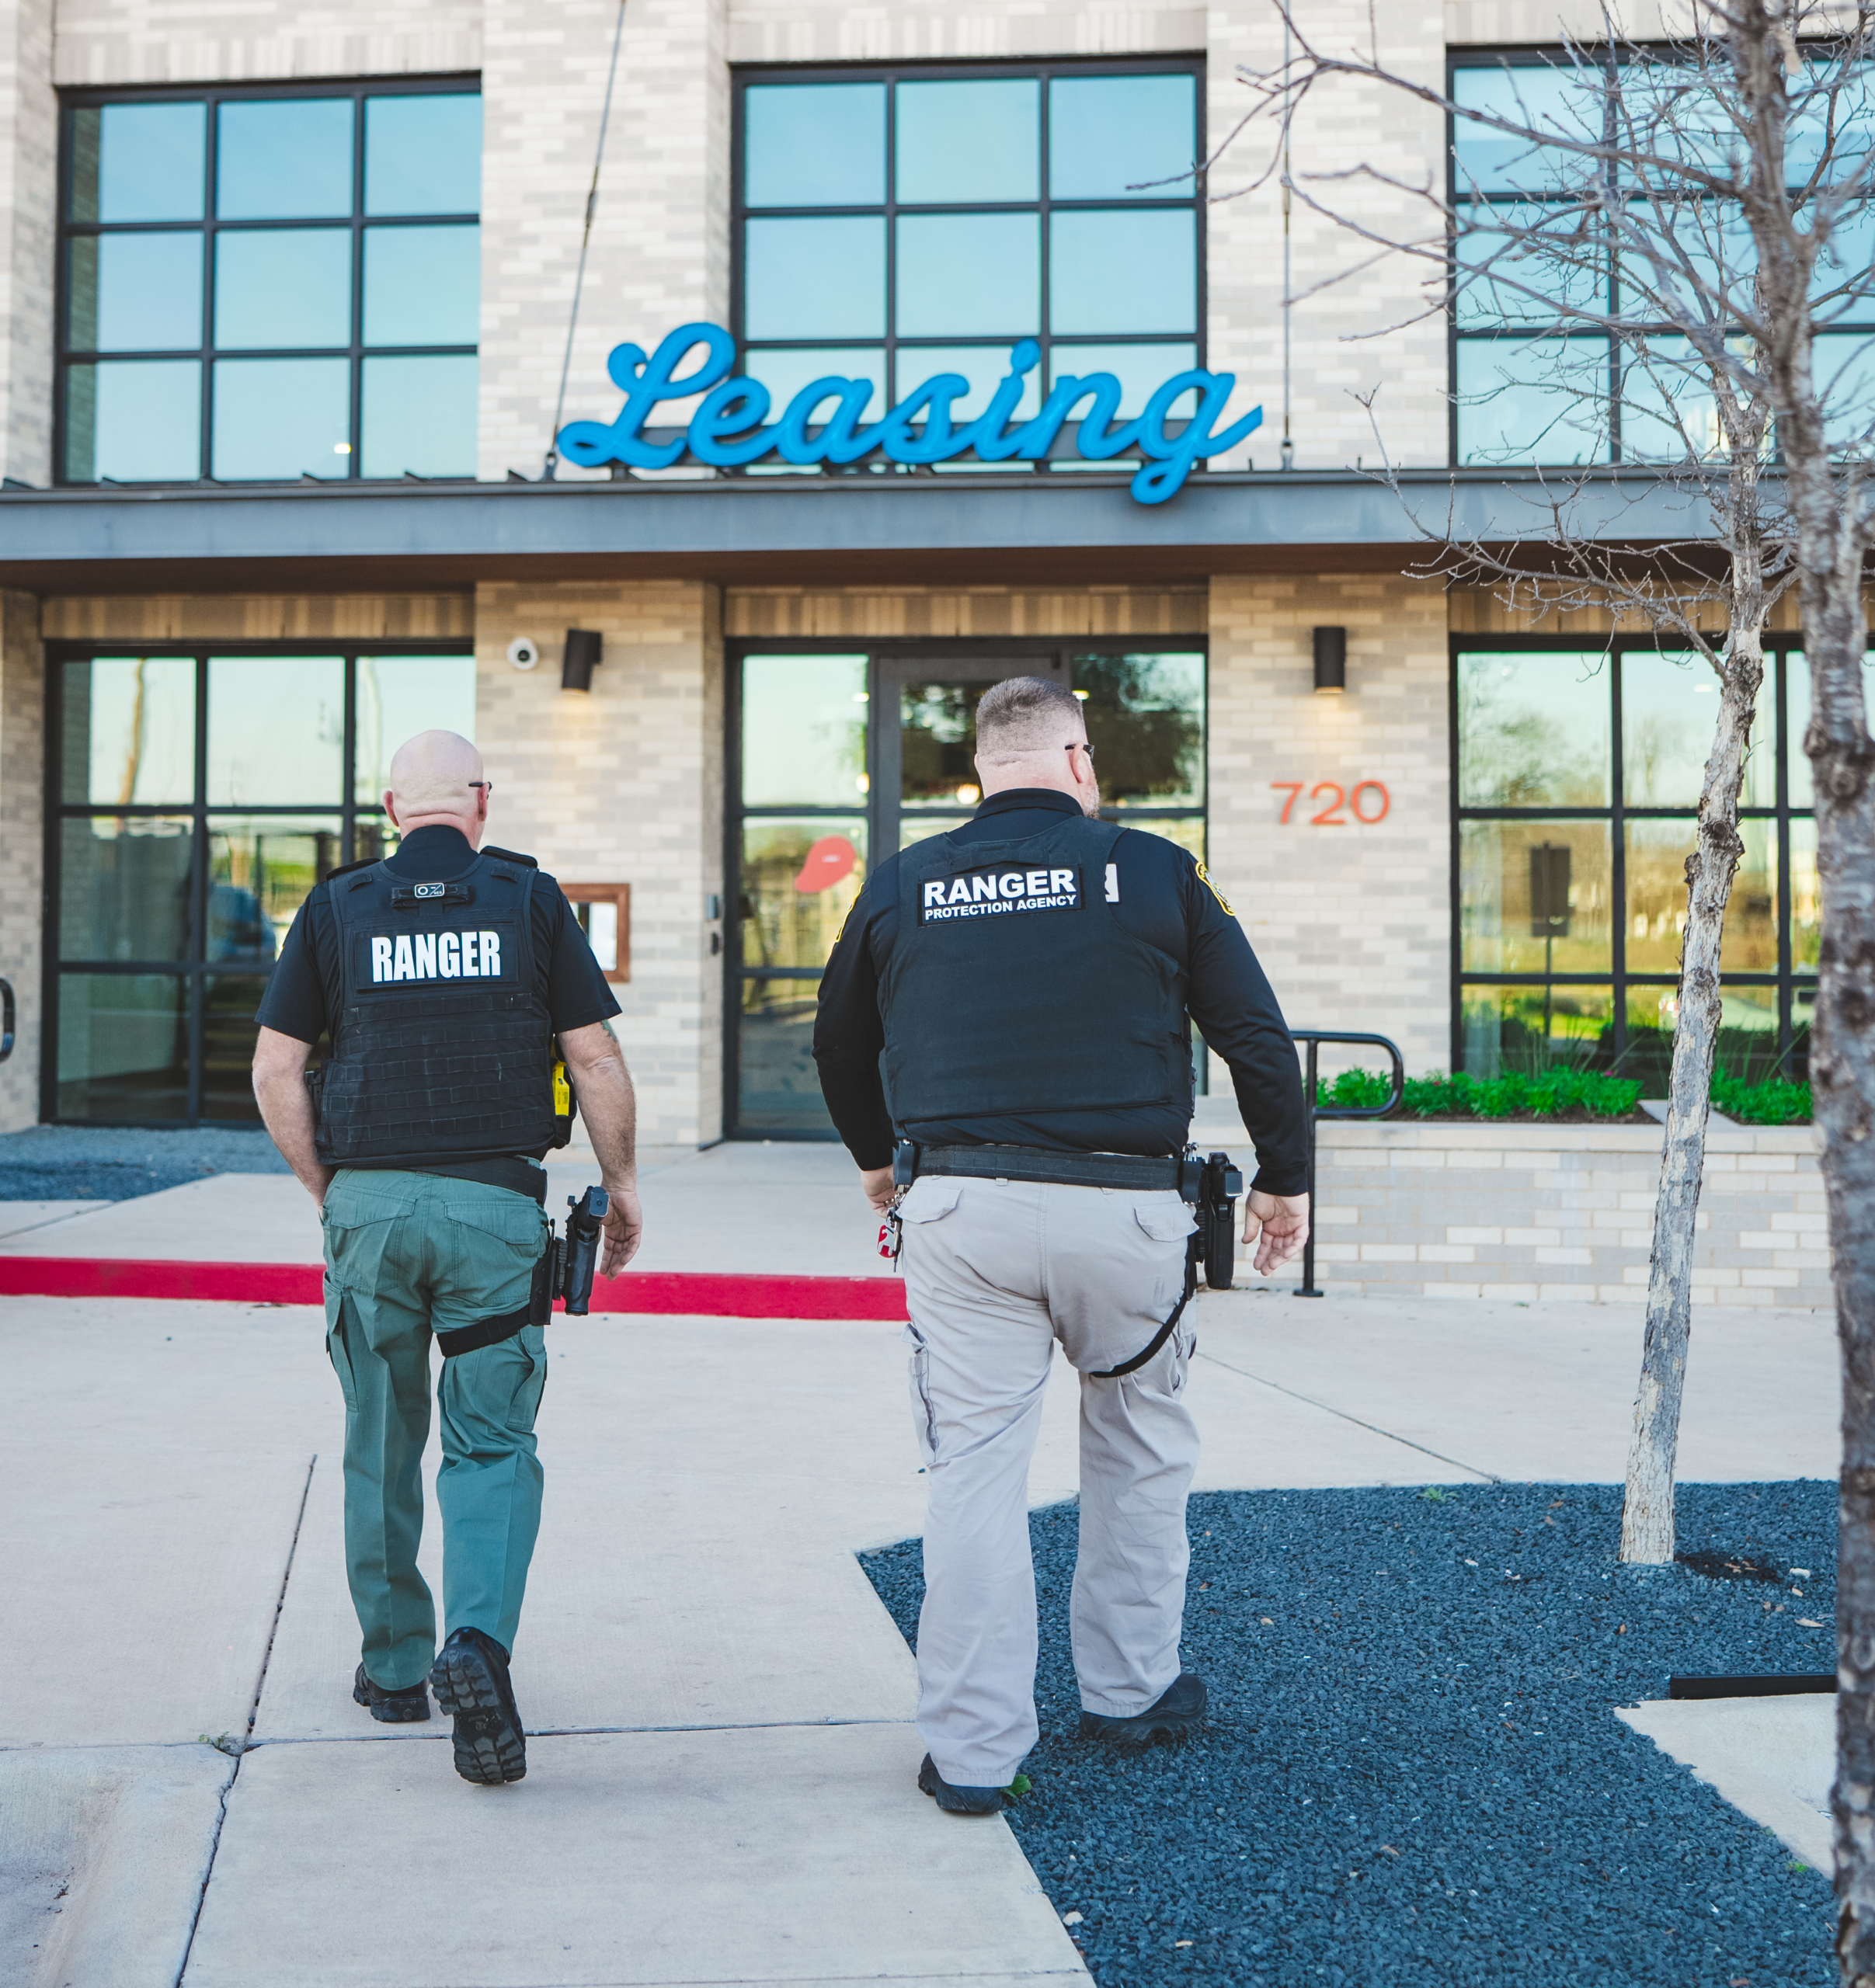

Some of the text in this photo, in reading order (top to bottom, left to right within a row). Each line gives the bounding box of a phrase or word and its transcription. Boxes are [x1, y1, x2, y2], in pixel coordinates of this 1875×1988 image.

[556, 322, 1263, 504] Leasing
[1271, 780, 1390, 824] 720
[924, 869, 1077, 907] RANGER
[925, 895, 1077, 920] PROTECTION AGENCY
[371, 930, 501, 982] RANGER
